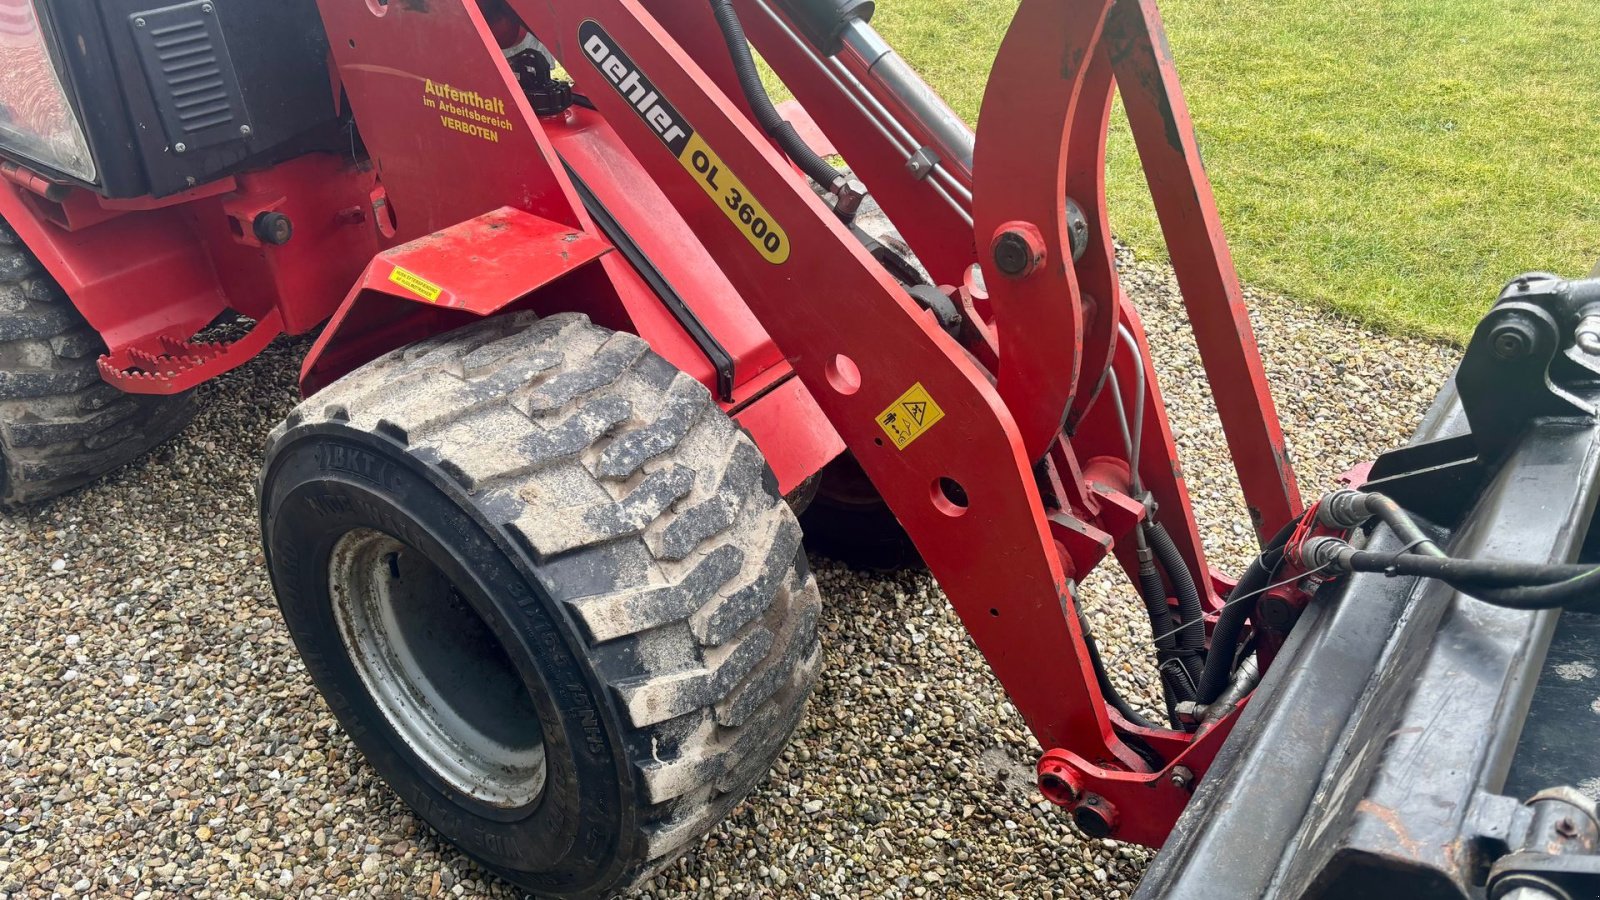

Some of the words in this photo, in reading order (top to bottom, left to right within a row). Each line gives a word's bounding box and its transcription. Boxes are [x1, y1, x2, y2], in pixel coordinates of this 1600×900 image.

[424, 79, 505, 115] Aufenthalt
[583, 34, 686, 144] oehler
[423, 95, 435, 108] im
[439, 100, 513, 131] Arbeitsbereich
[440, 115, 498, 142] VERBOTEN
[691, 149, 719, 192] OL
[724, 187, 781, 253] 3600
[334, 446, 375, 474] BKT
